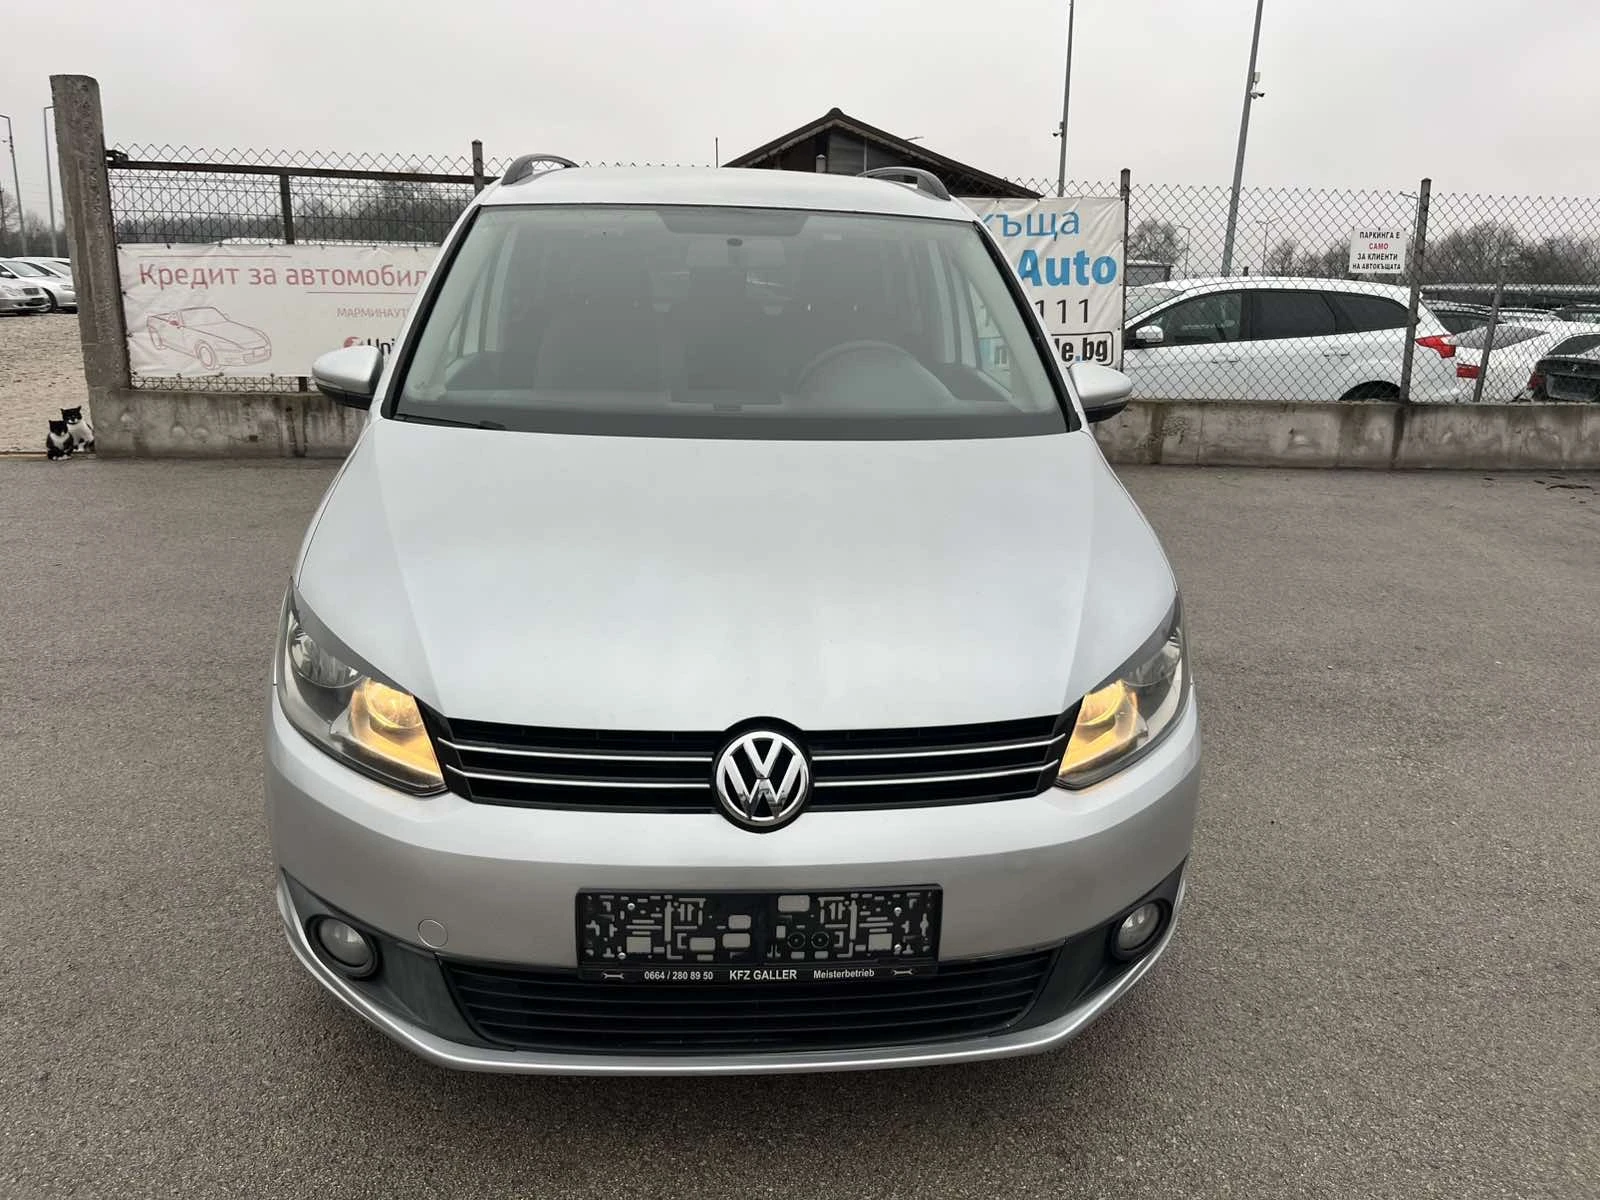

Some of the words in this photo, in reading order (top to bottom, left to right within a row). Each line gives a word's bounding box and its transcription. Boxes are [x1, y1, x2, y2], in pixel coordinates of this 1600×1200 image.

[1359, 231, 1394, 239] ПАРКИНГА
[1395, 231, 1401, 239] Е
[1368, 242, 1389, 250] САМО
[1357, 252, 1366, 260] ЗА
[1367, 252, 1398, 260] КЛИЕНТИ
[1018, 249, 1117, 287] Auto
[139, 263, 240, 290] Кредит
[248, 268, 277, 286] за
[336, 307, 410, 318] МАРМИНАУТ
[644, 970, 665, 980] 0664
[672, 970, 688, 980] 280
[690, 970, 701, 980] 89
[702, 970, 714, 980] 50
[729, 969, 751, 981] KFZ
[753, 969, 798, 980] GALLER
[813, 968, 875, 979] Meisterbetrieb
